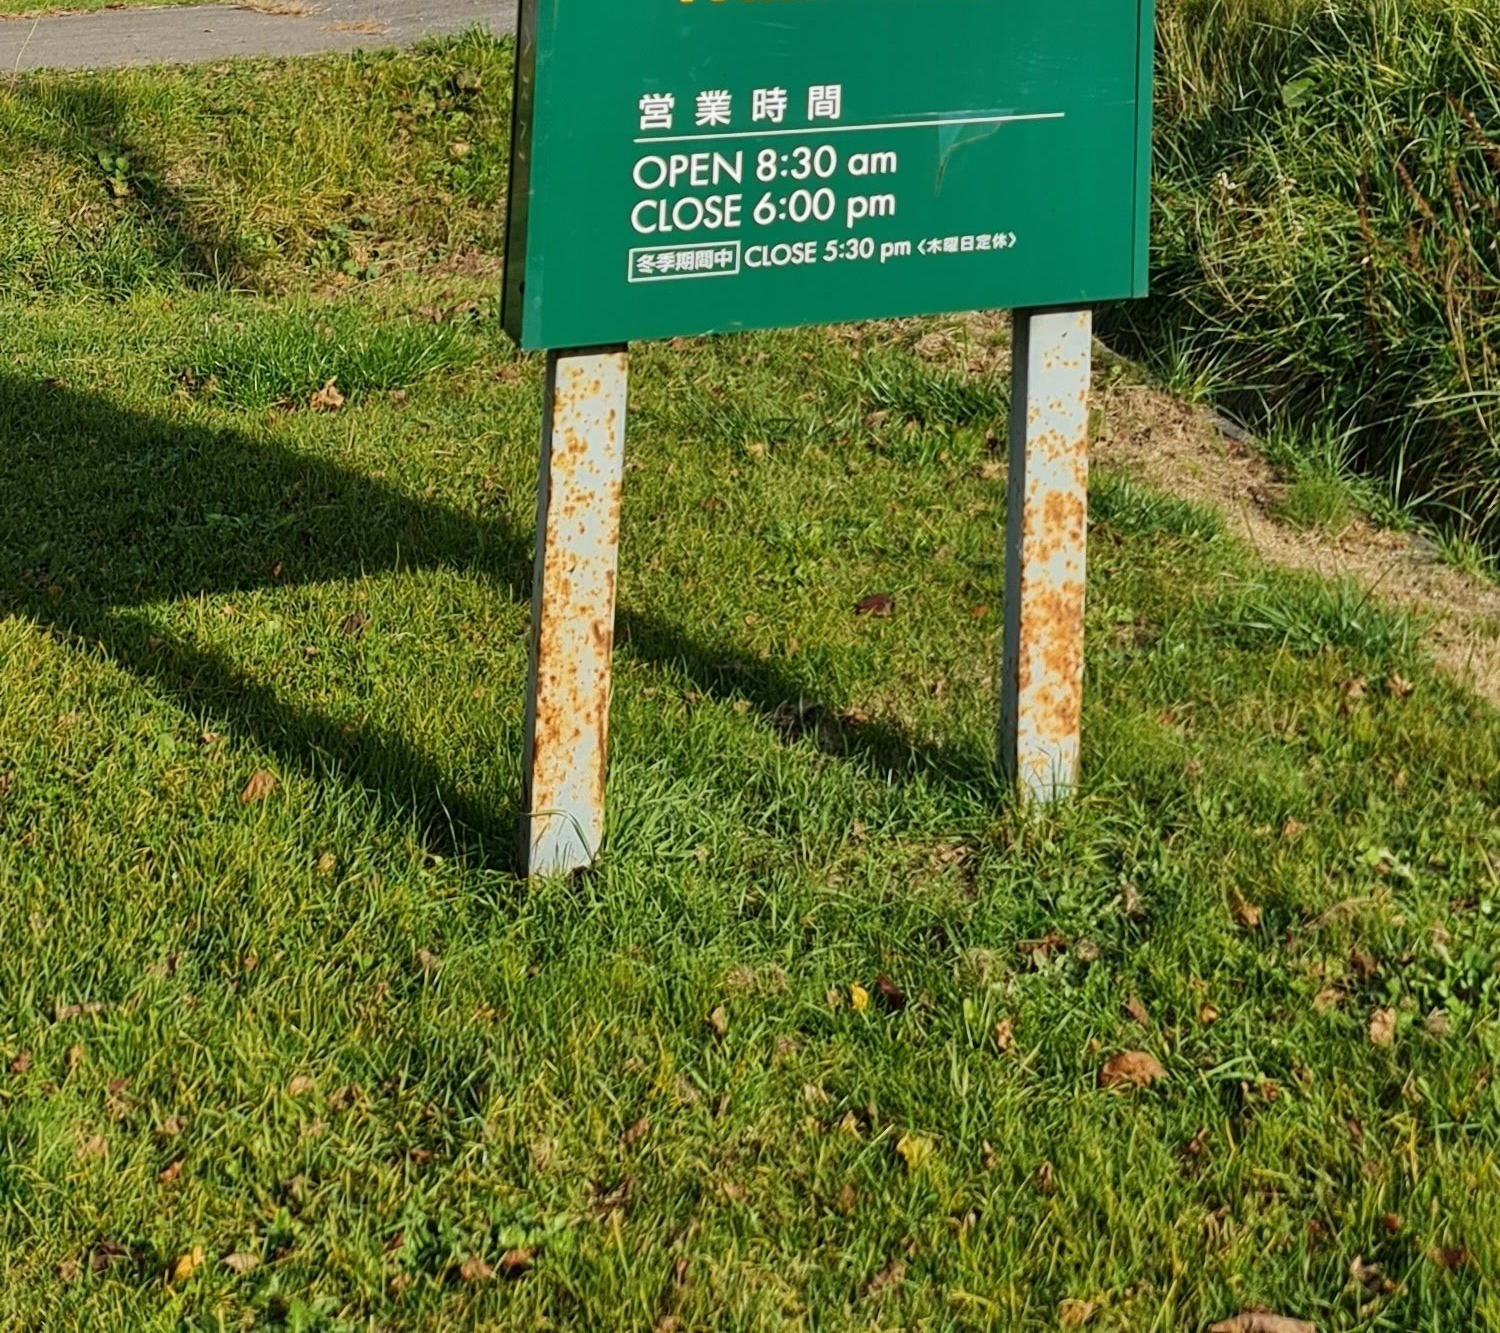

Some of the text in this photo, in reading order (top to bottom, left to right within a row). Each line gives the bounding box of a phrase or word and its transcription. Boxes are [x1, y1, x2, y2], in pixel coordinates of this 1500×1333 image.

[637, 84, 843, 131] 営業時間
[632, 144, 898, 191] OPEN 8:30 am
[630, 187, 896, 234] CLOSE 6:00 pm
[635, 247, 734, 276] 冬季期間中
[744, 240, 817, 269] CLOSE
[822, 236, 875, 262] 5:30
[879, 238, 911, 264] pm
